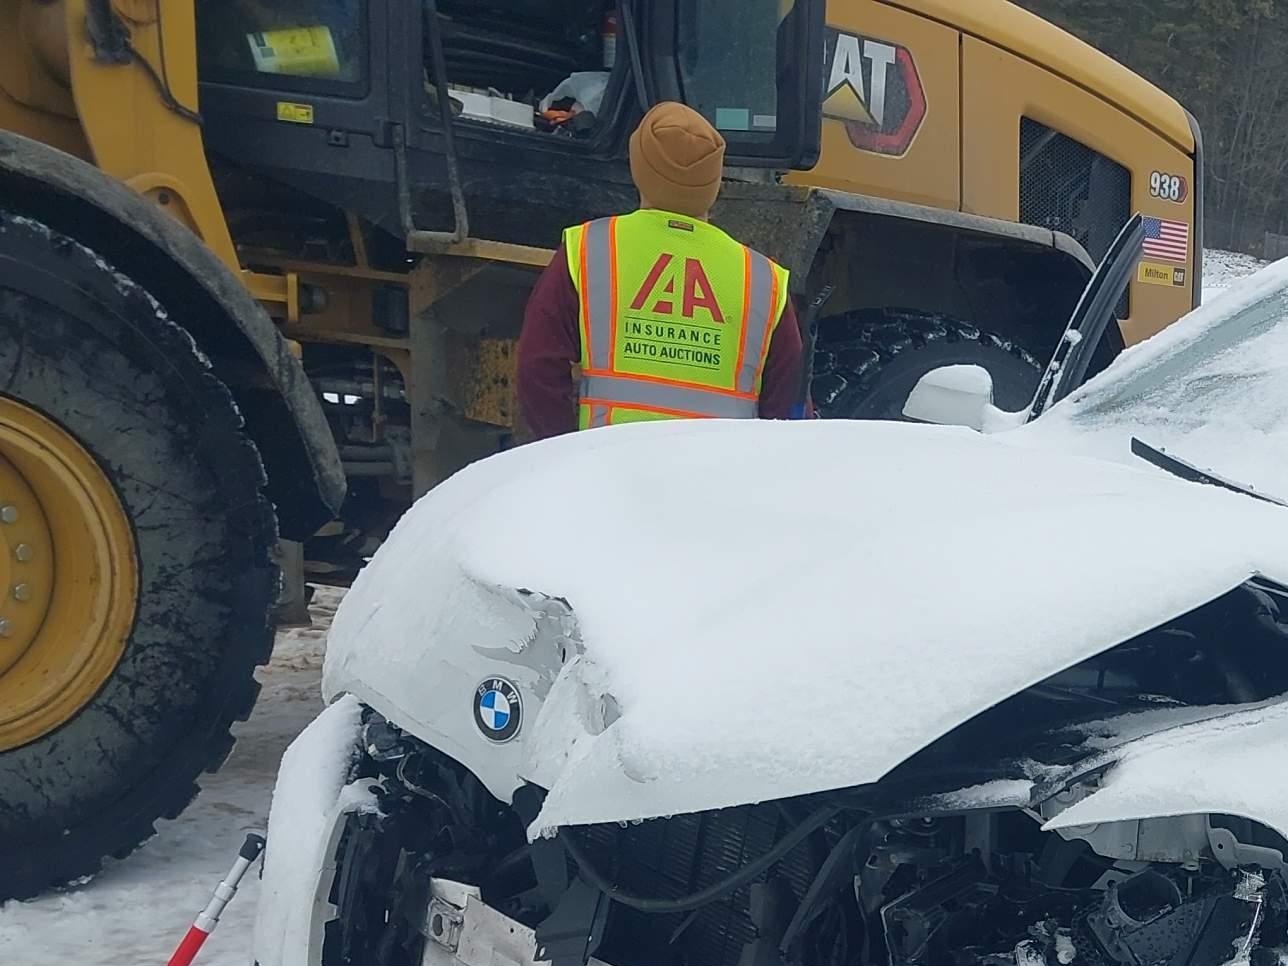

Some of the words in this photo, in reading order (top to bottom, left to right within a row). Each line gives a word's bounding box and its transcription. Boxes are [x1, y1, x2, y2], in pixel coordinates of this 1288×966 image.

[824, 33, 896, 127] AT
[1150, 171, 1180, 201] 938
[1144, 267, 1168, 280] Milton
[625, 322, 721, 345] INSURANCE
[624, 342, 657, 356] AUTO
[660, 346, 720, 365] AUCTIONS
[478, 680, 518, 704] BMW
